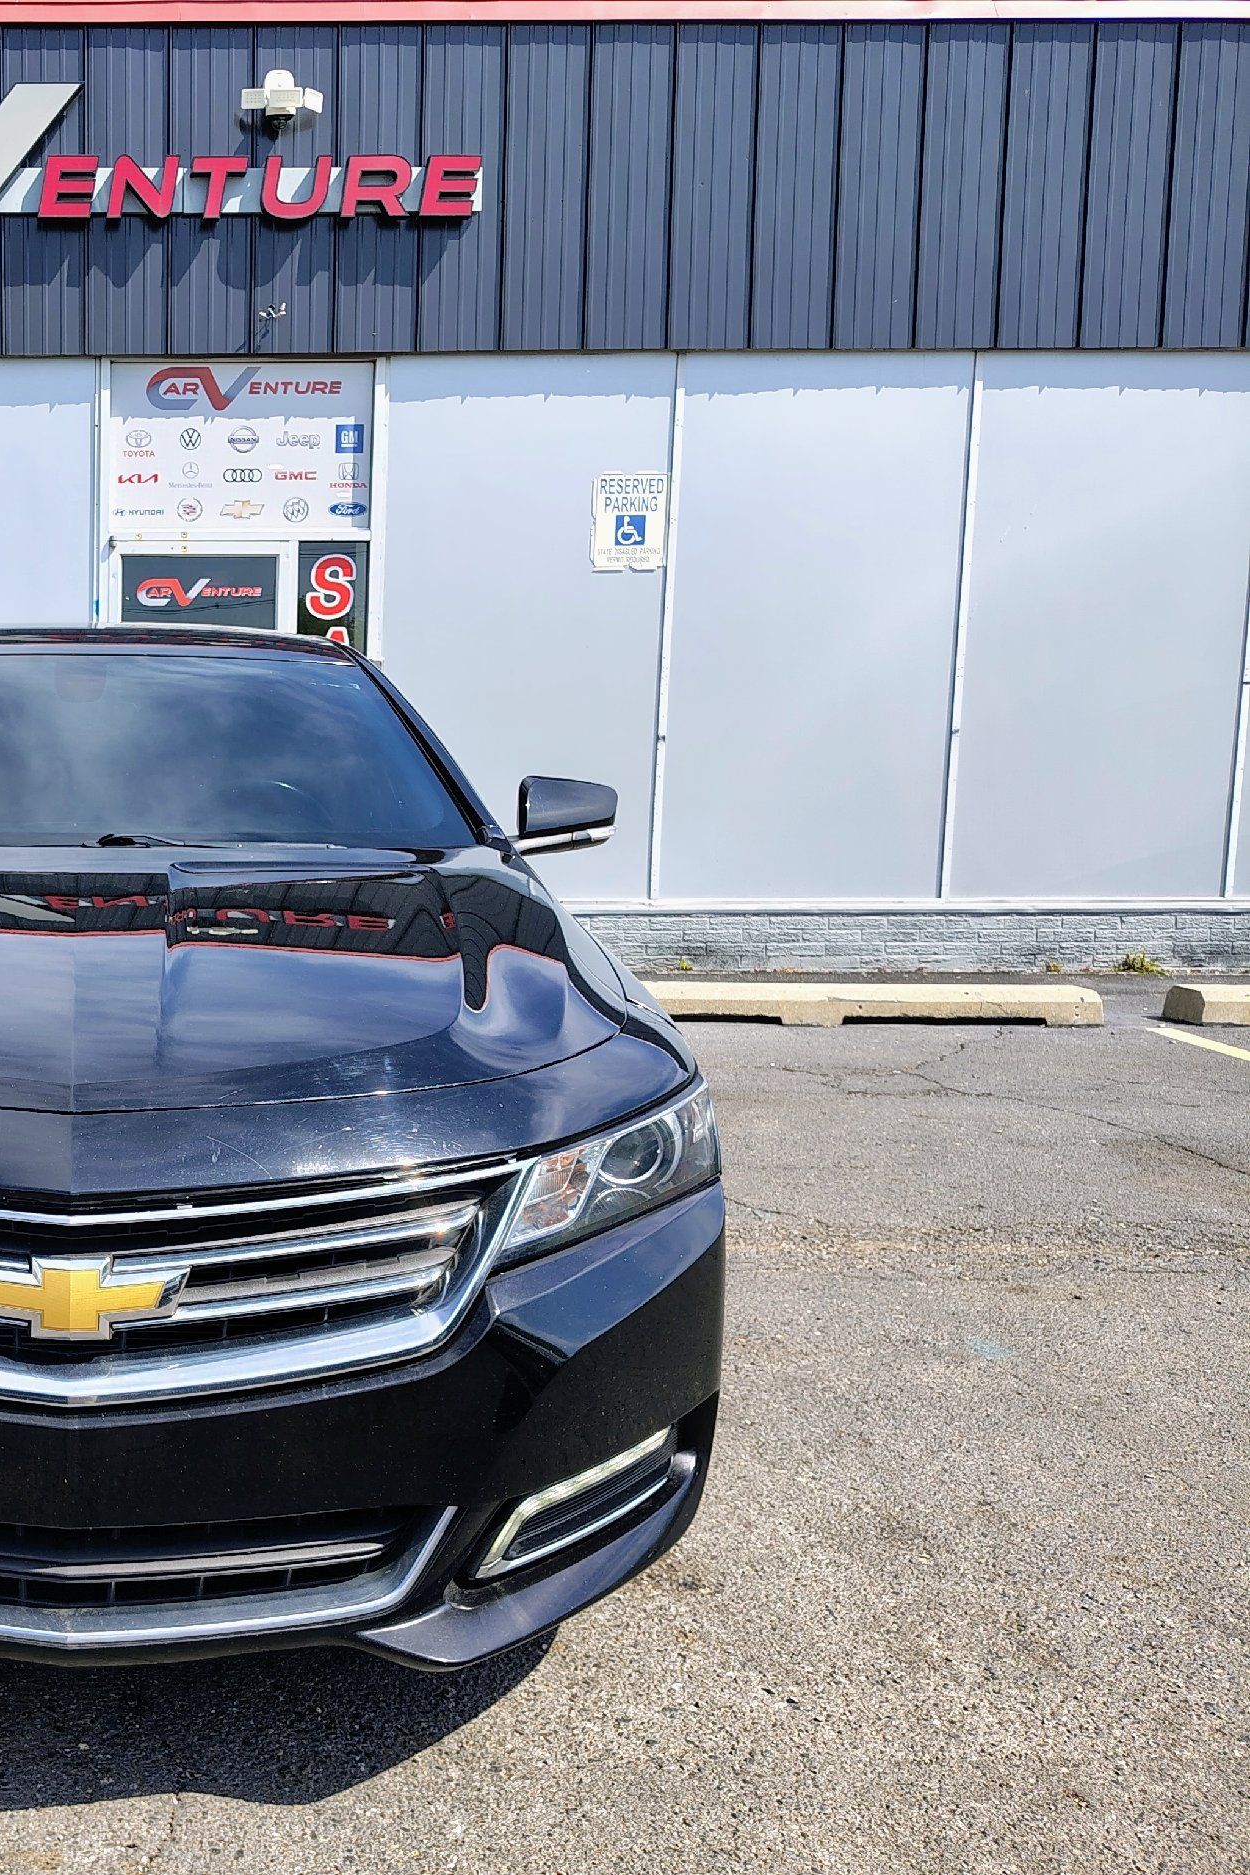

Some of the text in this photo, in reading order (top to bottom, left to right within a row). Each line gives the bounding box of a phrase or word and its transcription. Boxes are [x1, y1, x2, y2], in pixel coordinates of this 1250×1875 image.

[146, 366, 343, 411] CAR VENTURE
[275, 430, 321, 450] Jeep
[340, 430, 359, 444] GM
[123, 450, 156, 458] TOYOTA
[117, 473, 159, 485] KIA
[274, 471, 318, 481] GMC
[599, 478, 664, 495] RESERVED
[334, 504, 361, 516] Ford
[604, 496, 659, 513] PARKING
[128, 508, 165, 516] HYUNDAI
[136, 578, 180, 607] CAR
